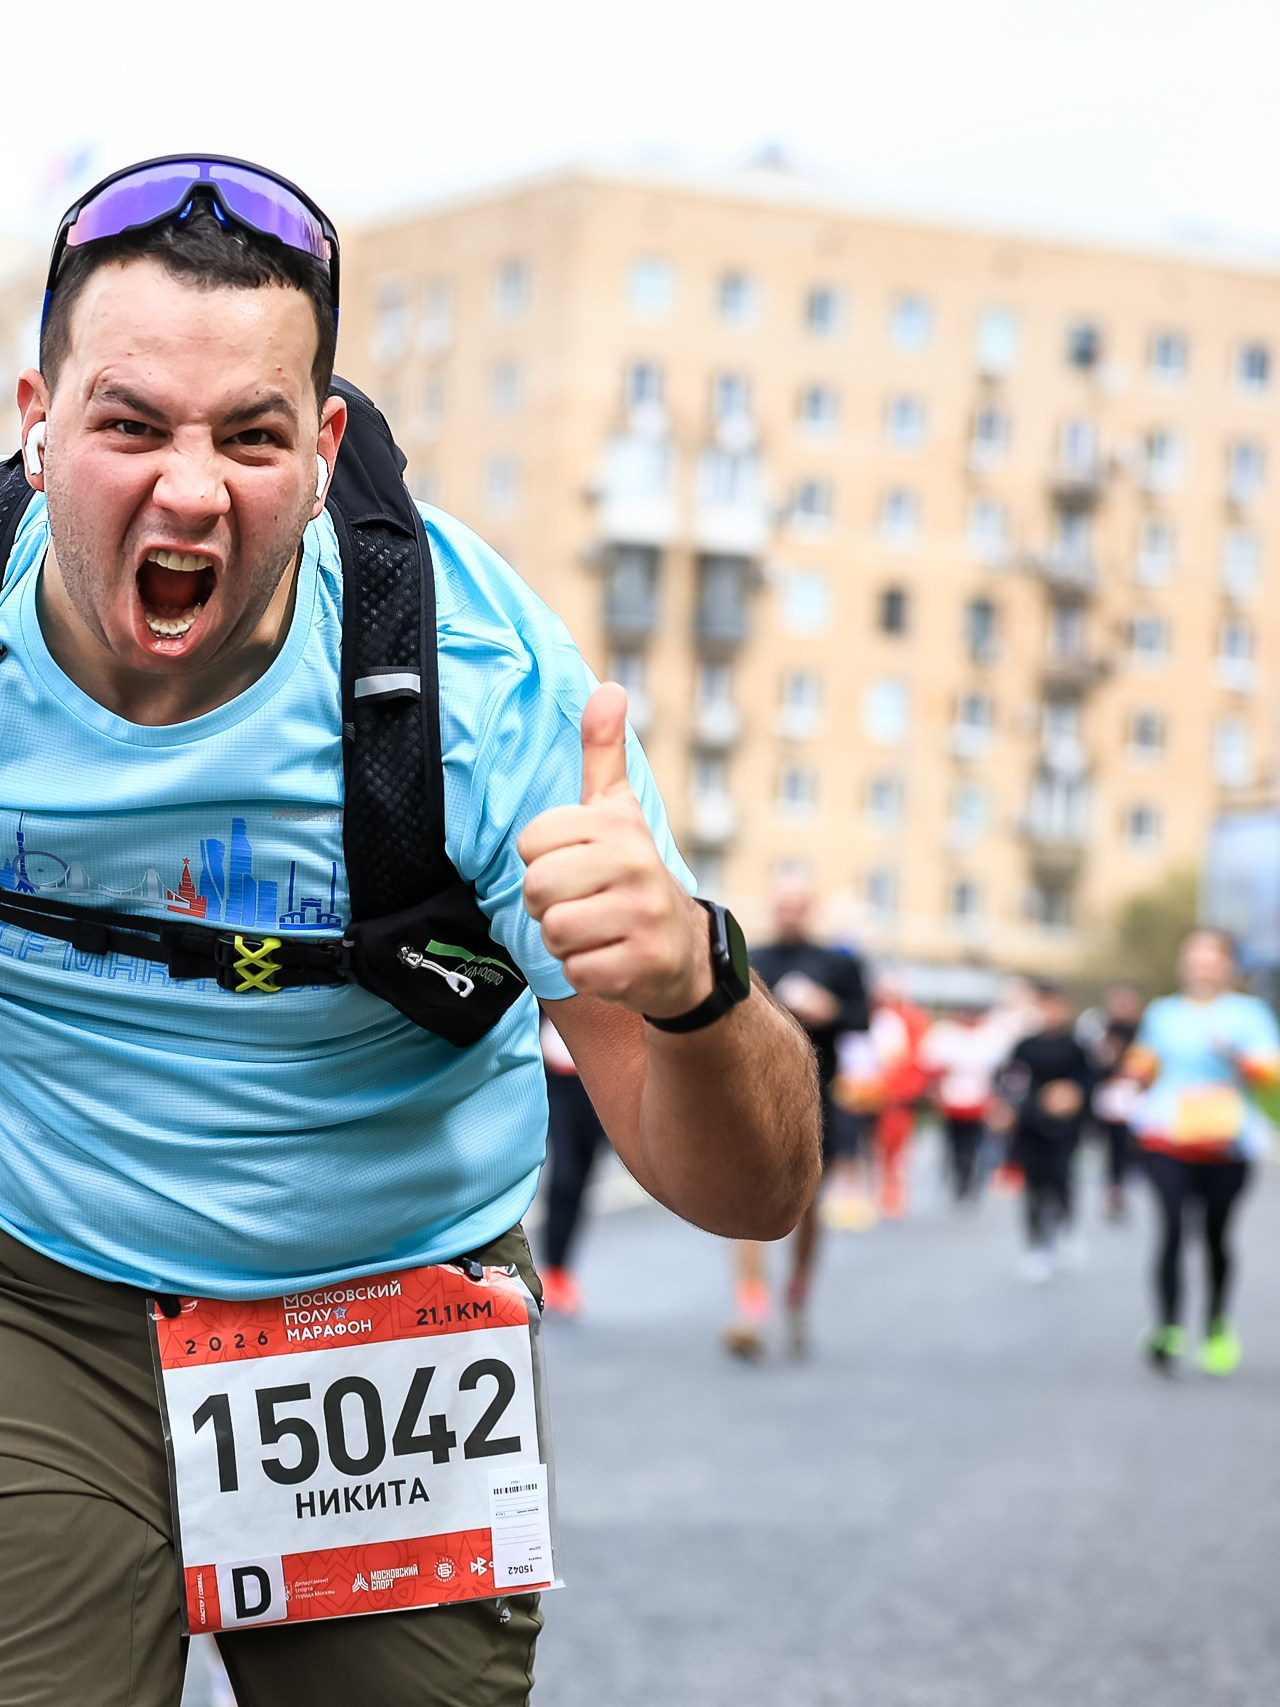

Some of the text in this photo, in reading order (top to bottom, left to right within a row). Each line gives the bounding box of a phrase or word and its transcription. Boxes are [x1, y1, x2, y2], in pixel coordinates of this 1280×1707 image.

[282, 1279, 402, 1310] МОСКОВСКИЙ
[284, 1307, 333, 1326] ПОЛУ
[286, 1319, 372, 1342] МАРАФОН
[185, 1331, 269, 1355] 2026
[192, 1358, 522, 1493] 15042
[295, 1476, 431, 1520] НИКИТА
[370, 1563, 419, 1581] МОСКОВСКИЙ
[507, 1564, 534, 1575] 15042
[231, 1565, 272, 1620] D
[371, 1578, 395, 1591] СПОРТ
